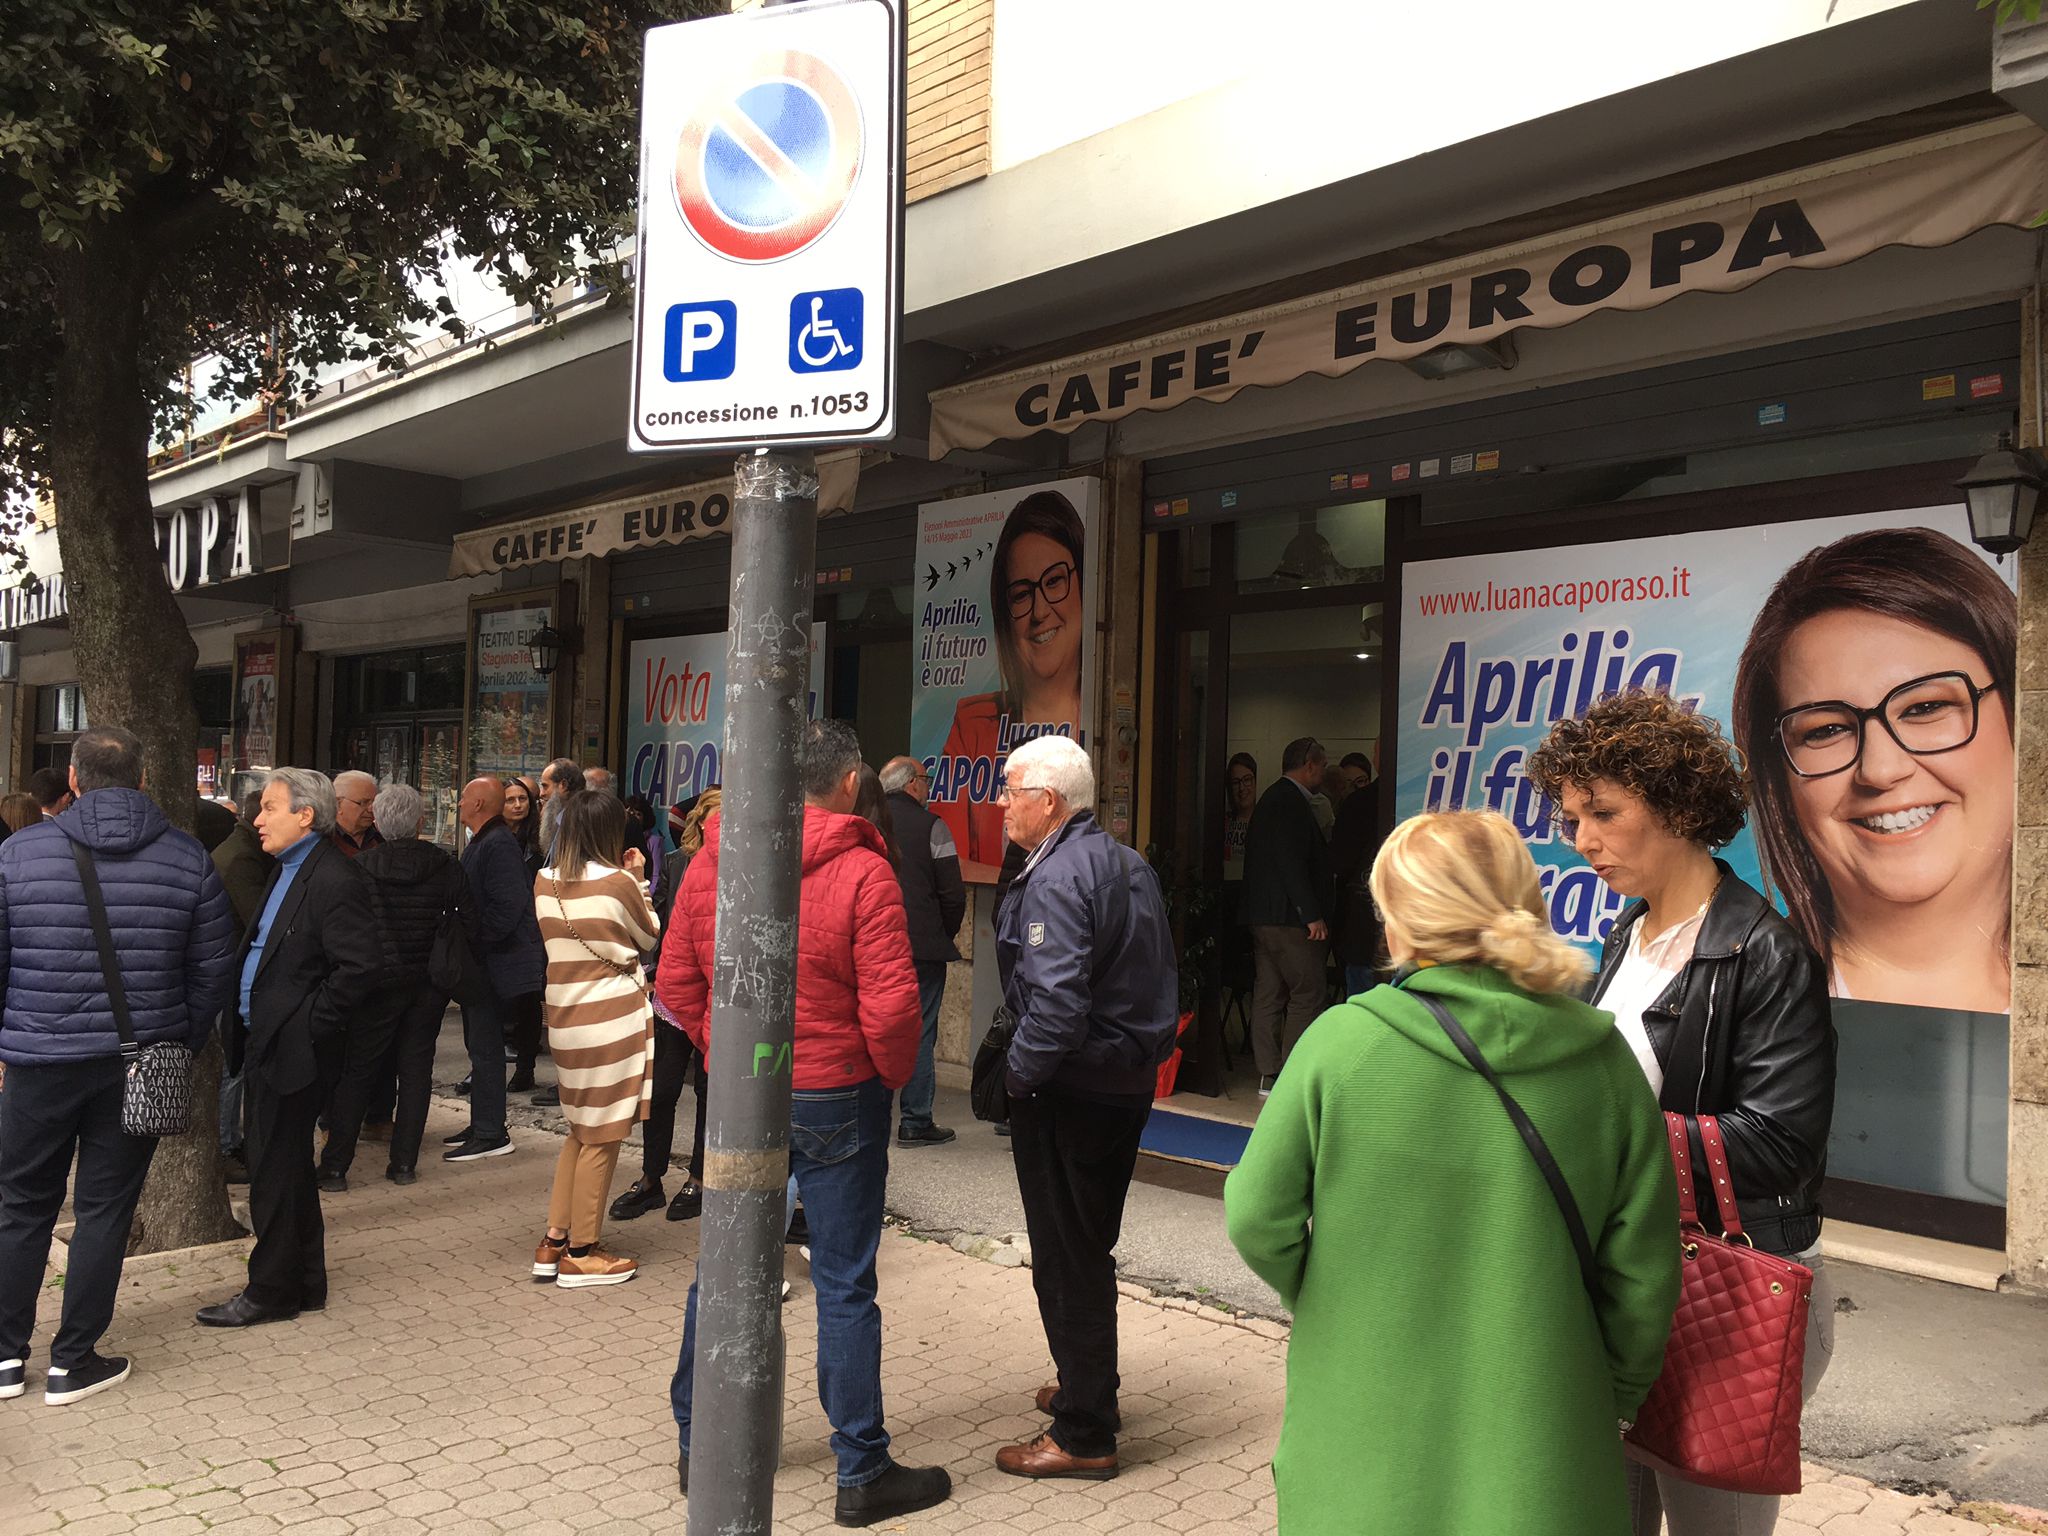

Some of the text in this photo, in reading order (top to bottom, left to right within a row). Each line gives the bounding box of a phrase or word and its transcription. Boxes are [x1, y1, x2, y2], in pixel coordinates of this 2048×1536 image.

[1015, 198, 1826, 427] CAFFE' EUROPA
[680, 310, 725, 373] P
[645, 391, 869, 427] concessione n.1053
[492, 493, 730, 565] CAFFE' EURO
[11, 573, 68, 628] TEATR
[1419, 566, 1691, 616] www.luanacaporaso.it
[921, 598, 982, 633] Aprilia,
[480, 631, 515, 648] TEATRO
[482, 652, 518, 668] Stagione
[921, 632, 987, 660] il futuro
[480, 672, 505, 688] Aprilia
[645, 656, 711, 724] Vota
[921, 659, 968, 687] è ora!
[1484, 750, 1560, 840] fu
